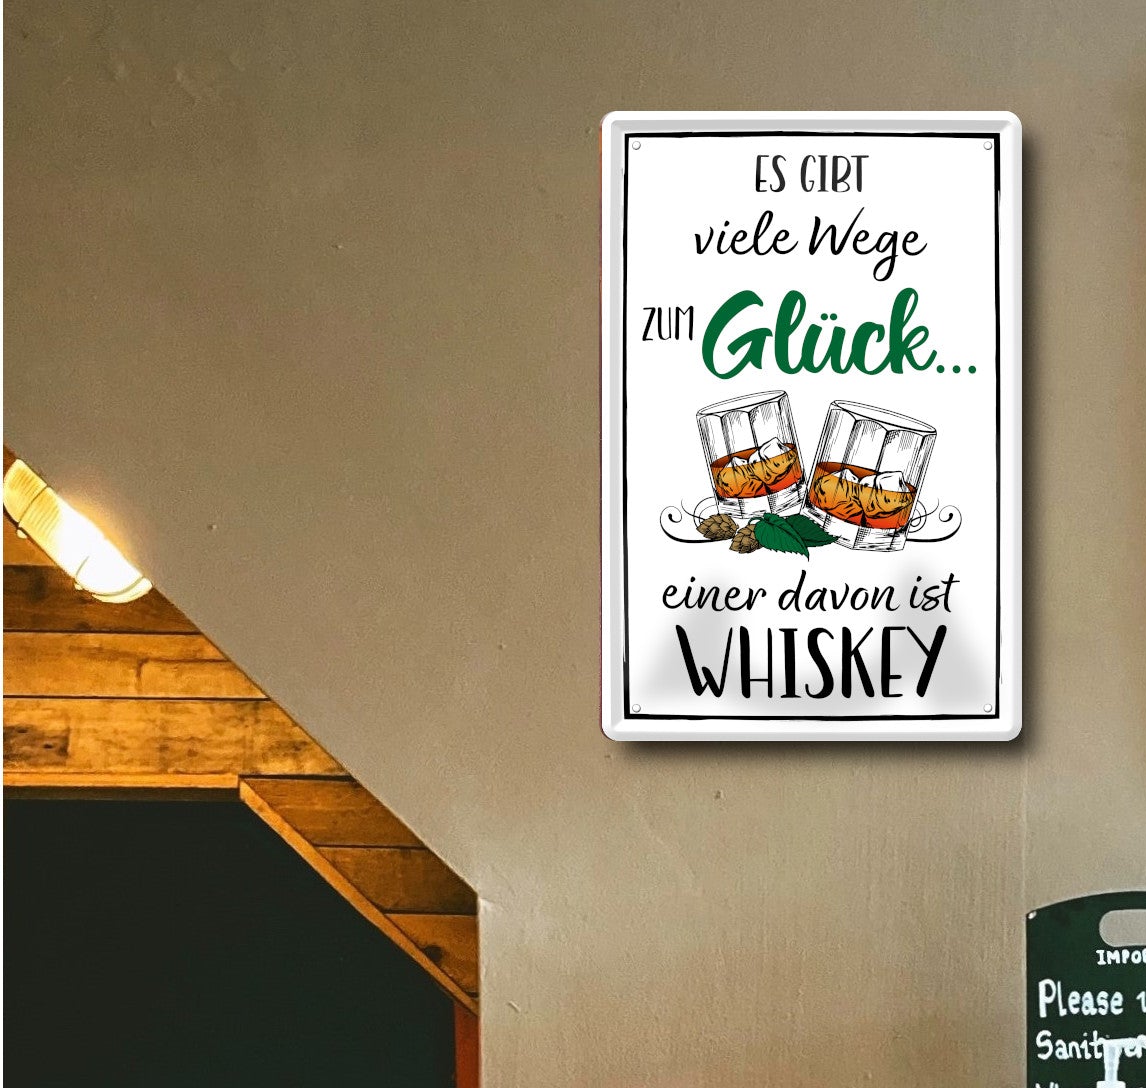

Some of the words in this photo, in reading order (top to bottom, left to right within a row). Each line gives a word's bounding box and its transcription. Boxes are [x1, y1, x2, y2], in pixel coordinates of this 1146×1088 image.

[755, 155, 786, 193] ES
[800, 154, 870, 193] GIBT
[694, 210, 798, 257] viele
[807, 206, 928, 282] Wege
[642, 305, 695, 342] ZUM
[662, 574, 768, 613] einer
[778, 570, 900, 613] davon
[909, 573, 960, 613] ist
[675, 624, 948, 700] WHISKEY
[1038, 979, 1124, 1018] Please
